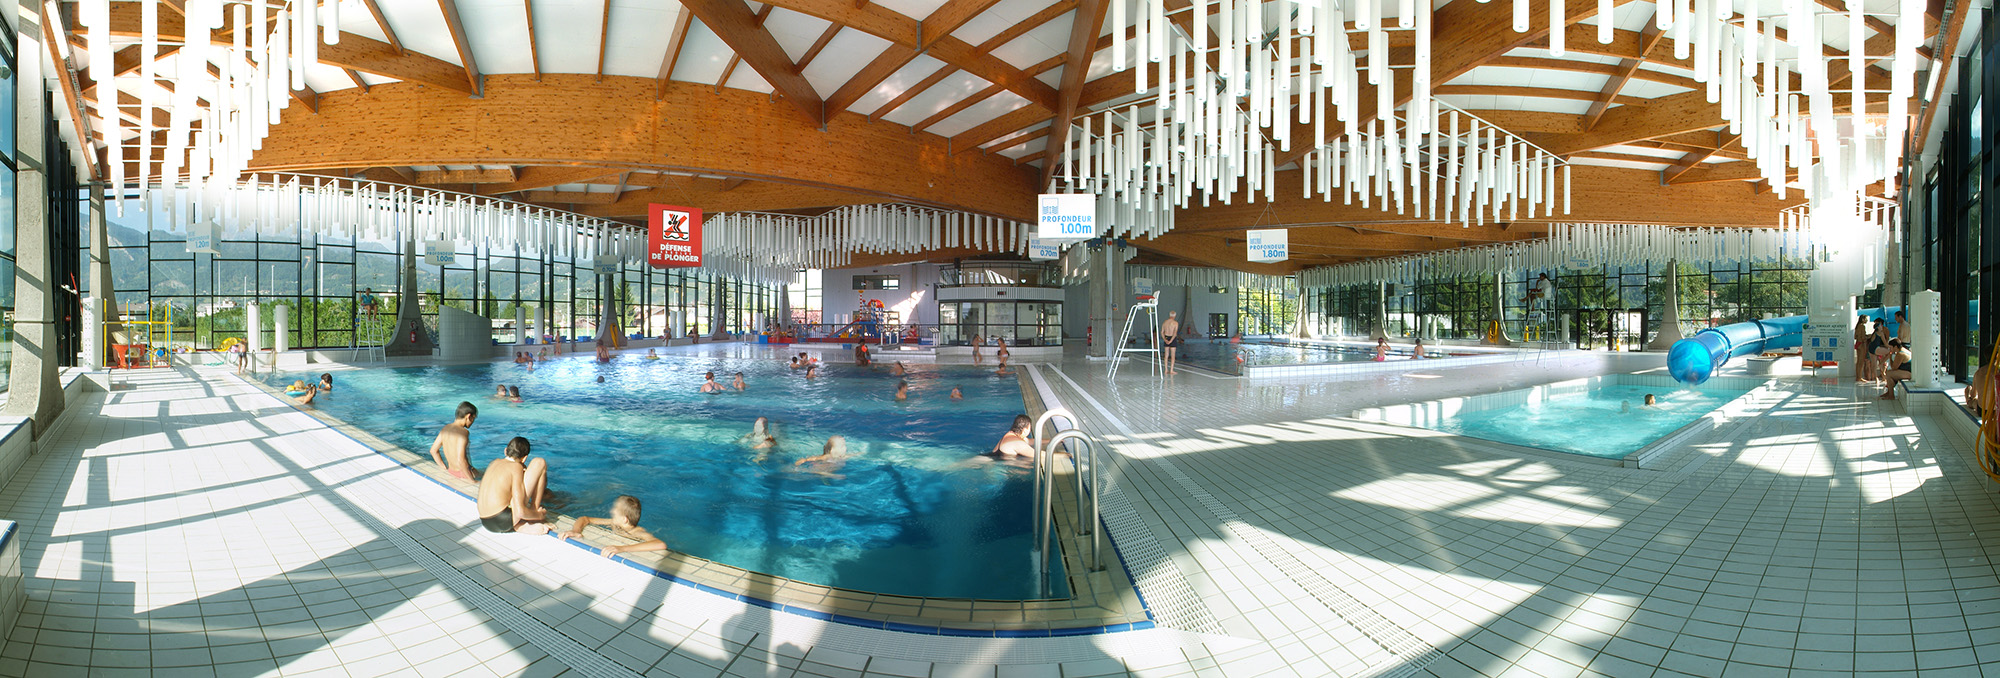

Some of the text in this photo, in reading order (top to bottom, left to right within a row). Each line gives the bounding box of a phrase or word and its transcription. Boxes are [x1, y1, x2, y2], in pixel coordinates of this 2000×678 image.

[1042, 215, 1092, 223] PROFONDEUR
[1060, 223, 1092, 234] 1.00m
[195, 241, 210, 249] 1.20m
[660, 242, 692, 253] DÉFENSE
[1262, 249, 1286, 258] 1.80m
[664, 254, 699, 263] PLONGER
